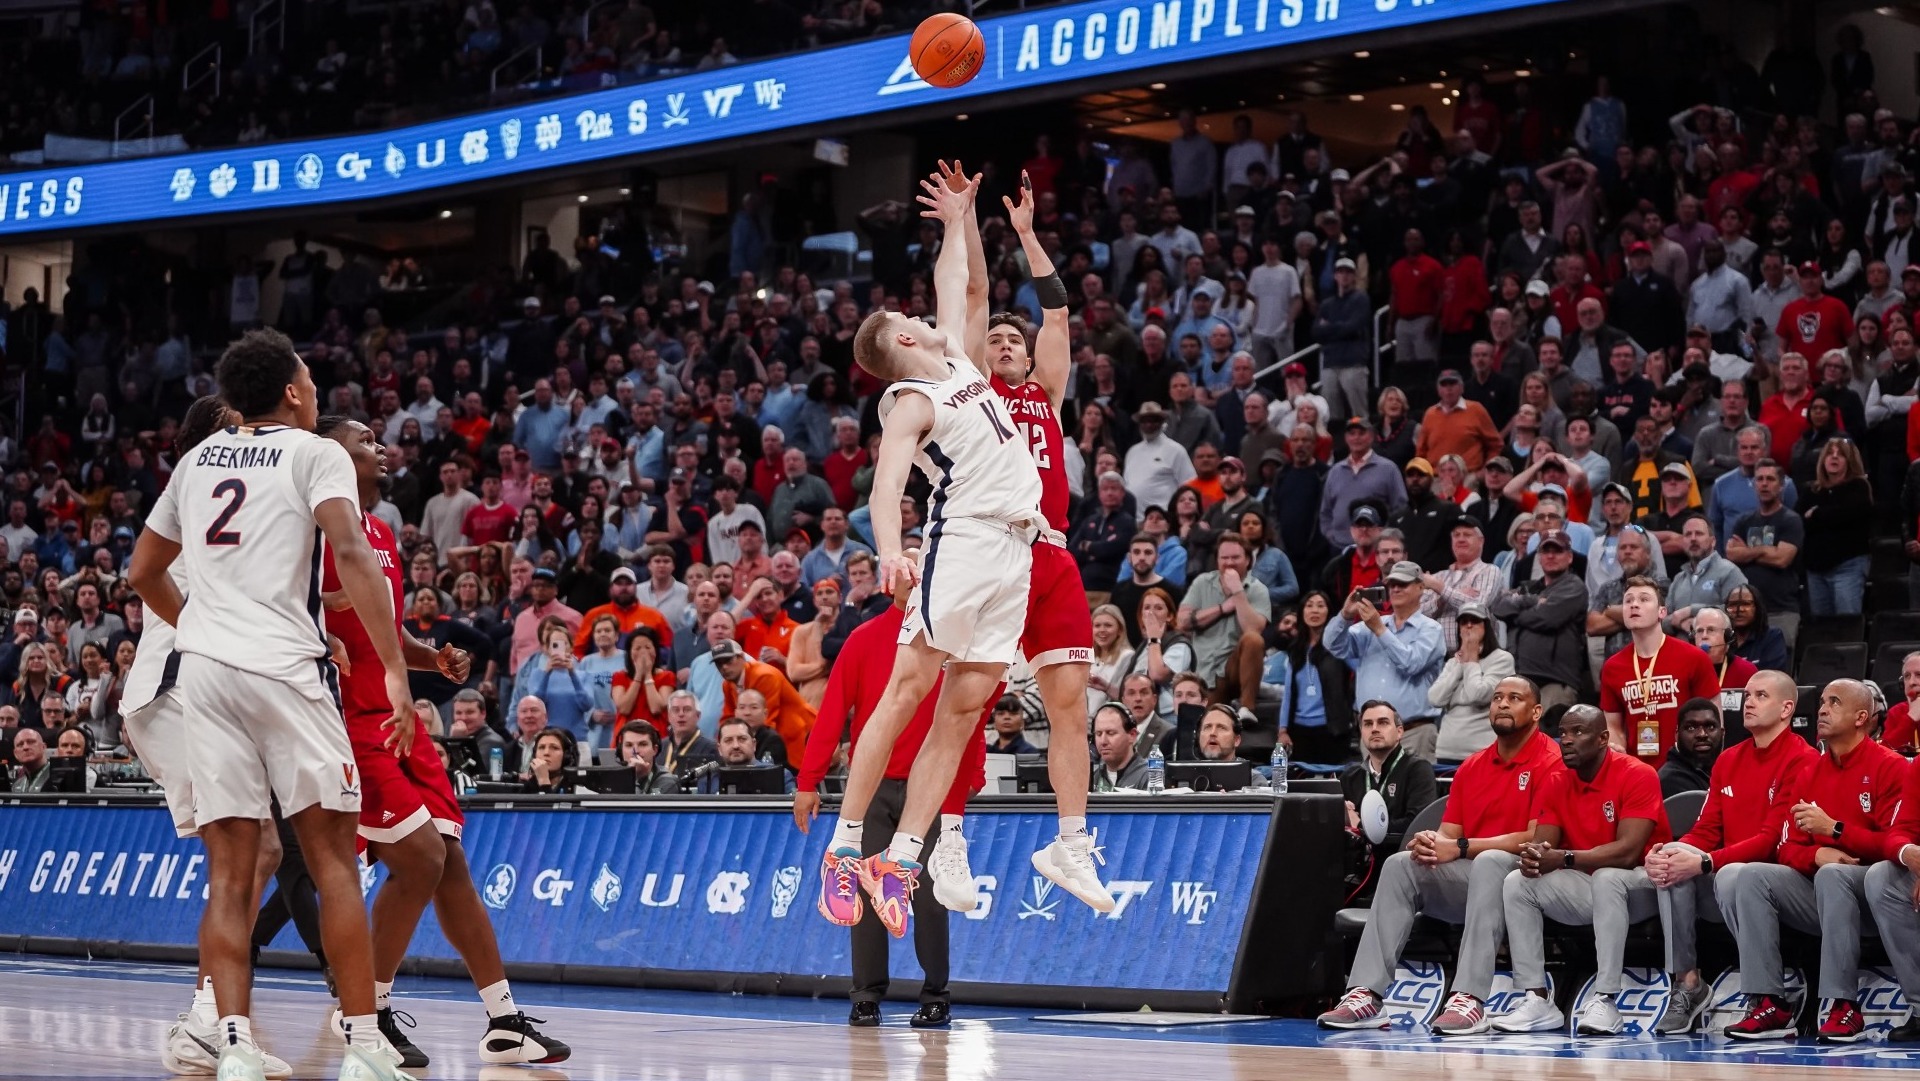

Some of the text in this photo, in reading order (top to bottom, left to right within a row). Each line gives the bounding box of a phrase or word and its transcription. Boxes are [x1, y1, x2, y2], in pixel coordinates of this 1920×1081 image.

[196, 445, 283, 469] BEEKMAN
[1017, 422, 1051, 469] 12
[205, 478, 248, 546] 2
[1068, 649, 1089, 660] PACK
[1621, 679, 1680, 702] WOLPACK
[29, 850, 210, 900] GREATNE
[1616, 989, 1669, 1011] CC
